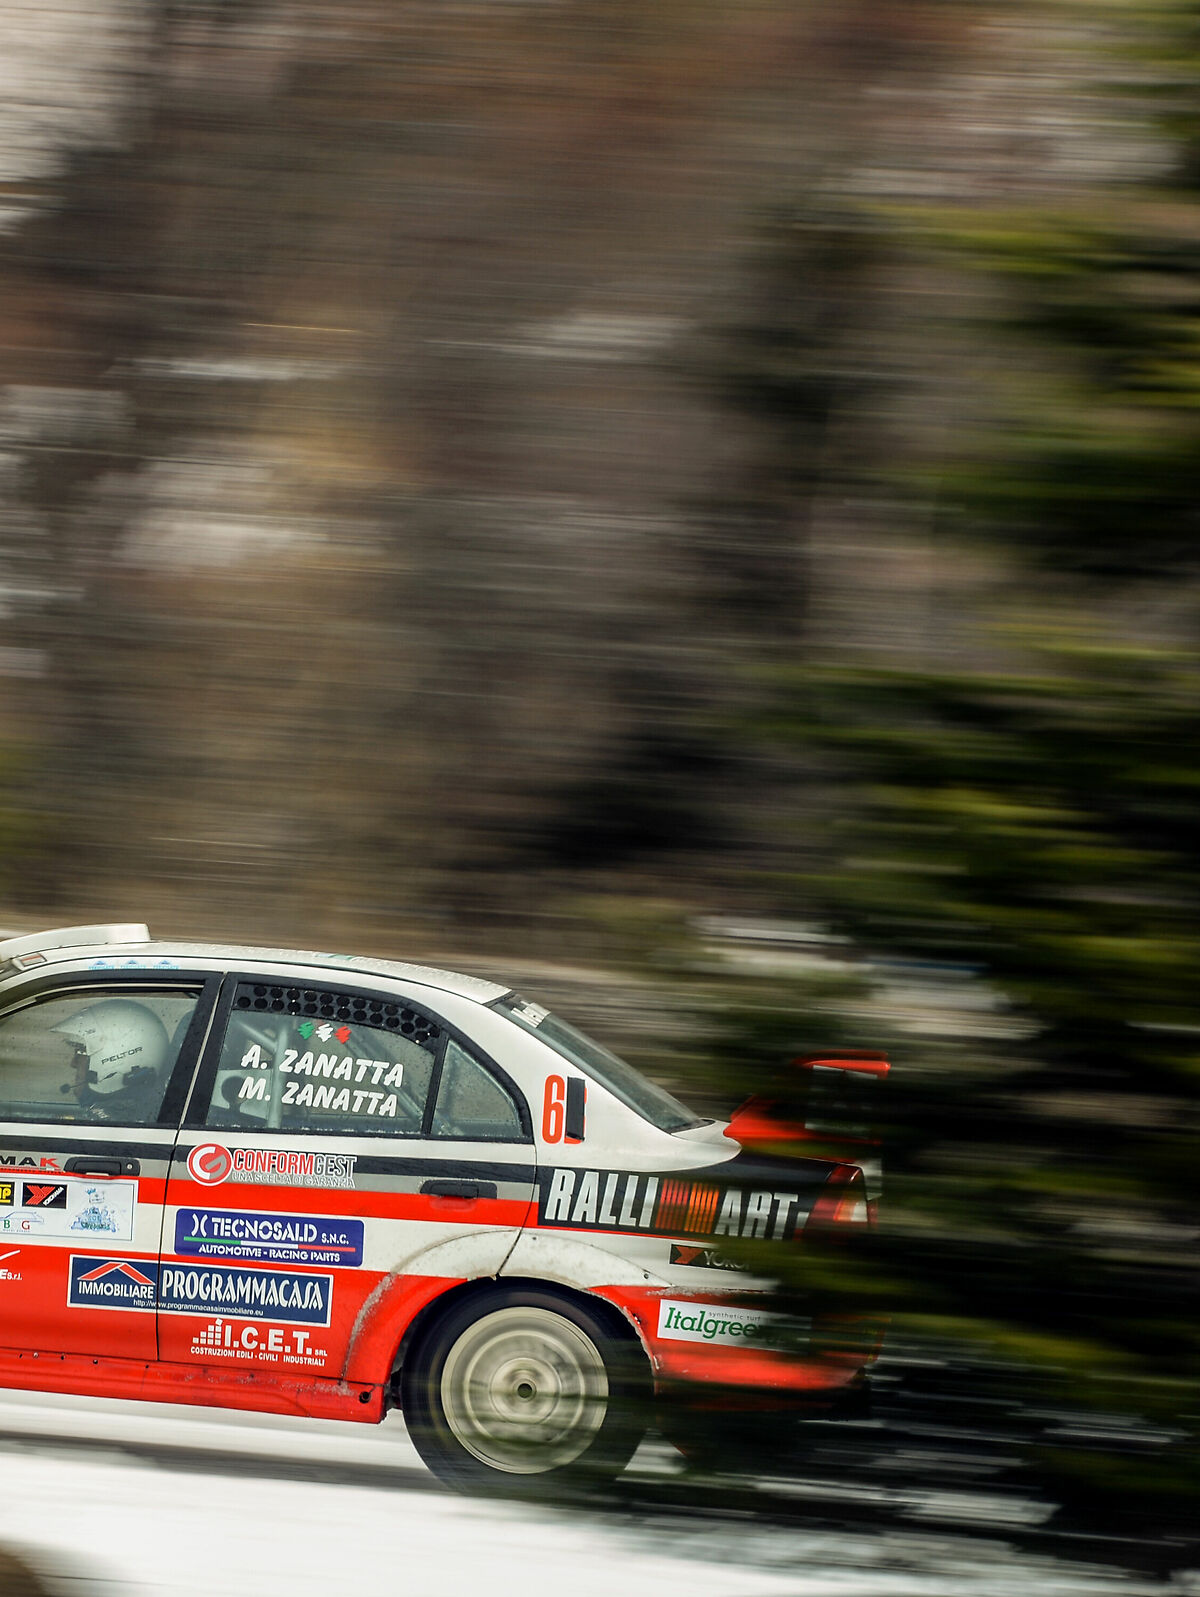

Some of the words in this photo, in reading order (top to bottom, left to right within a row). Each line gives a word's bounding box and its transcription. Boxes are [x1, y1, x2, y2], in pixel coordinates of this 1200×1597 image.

[101, 1046, 144, 1064] PELTOR
[241, 1044, 267, 1070] A.
[279, 1049, 404, 1087] ZANATTA
[238, 1076, 271, 1101] M.
[281, 1081, 398, 1117] ZANATTA
[233, 1149, 357, 1178] CONFORMGEST
[232, 1171, 254, 1183] UNA
[304, 1177, 356, 1189] GARANZIA
[544, 1168, 659, 1228] RALLI
[714, 1188, 799, 1241] ART
[211, 1217, 318, 1243] TECNOSALD
[321, 1232, 349, 1245] S.N.C.
[198, 1244, 262, 1258] AUTOMOTIVE
[269, 1248, 308, 1261] RACING
[310, 1251, 340, 1263] PARTS
[78, 1281, 154, 1299] IMMOBILIARE
[162, 1269, 324, 1311] PROGRAMMACASA
[664, 1307, 763, 1339] Italgree
[708, 1311, 743, 1320] synthetic
[224, 1325, 312, 1355] I.C.E.T.
[314, 1349, 328, 1357] SRL
[190, 1346, 236, 1358] COSTRUZIONI
[236, 1350, 254, 1360] EDILI
[258, 1352, 279, 1362] CIVILI
[283, 1355, 325, 1367] INDUSTRIALI
